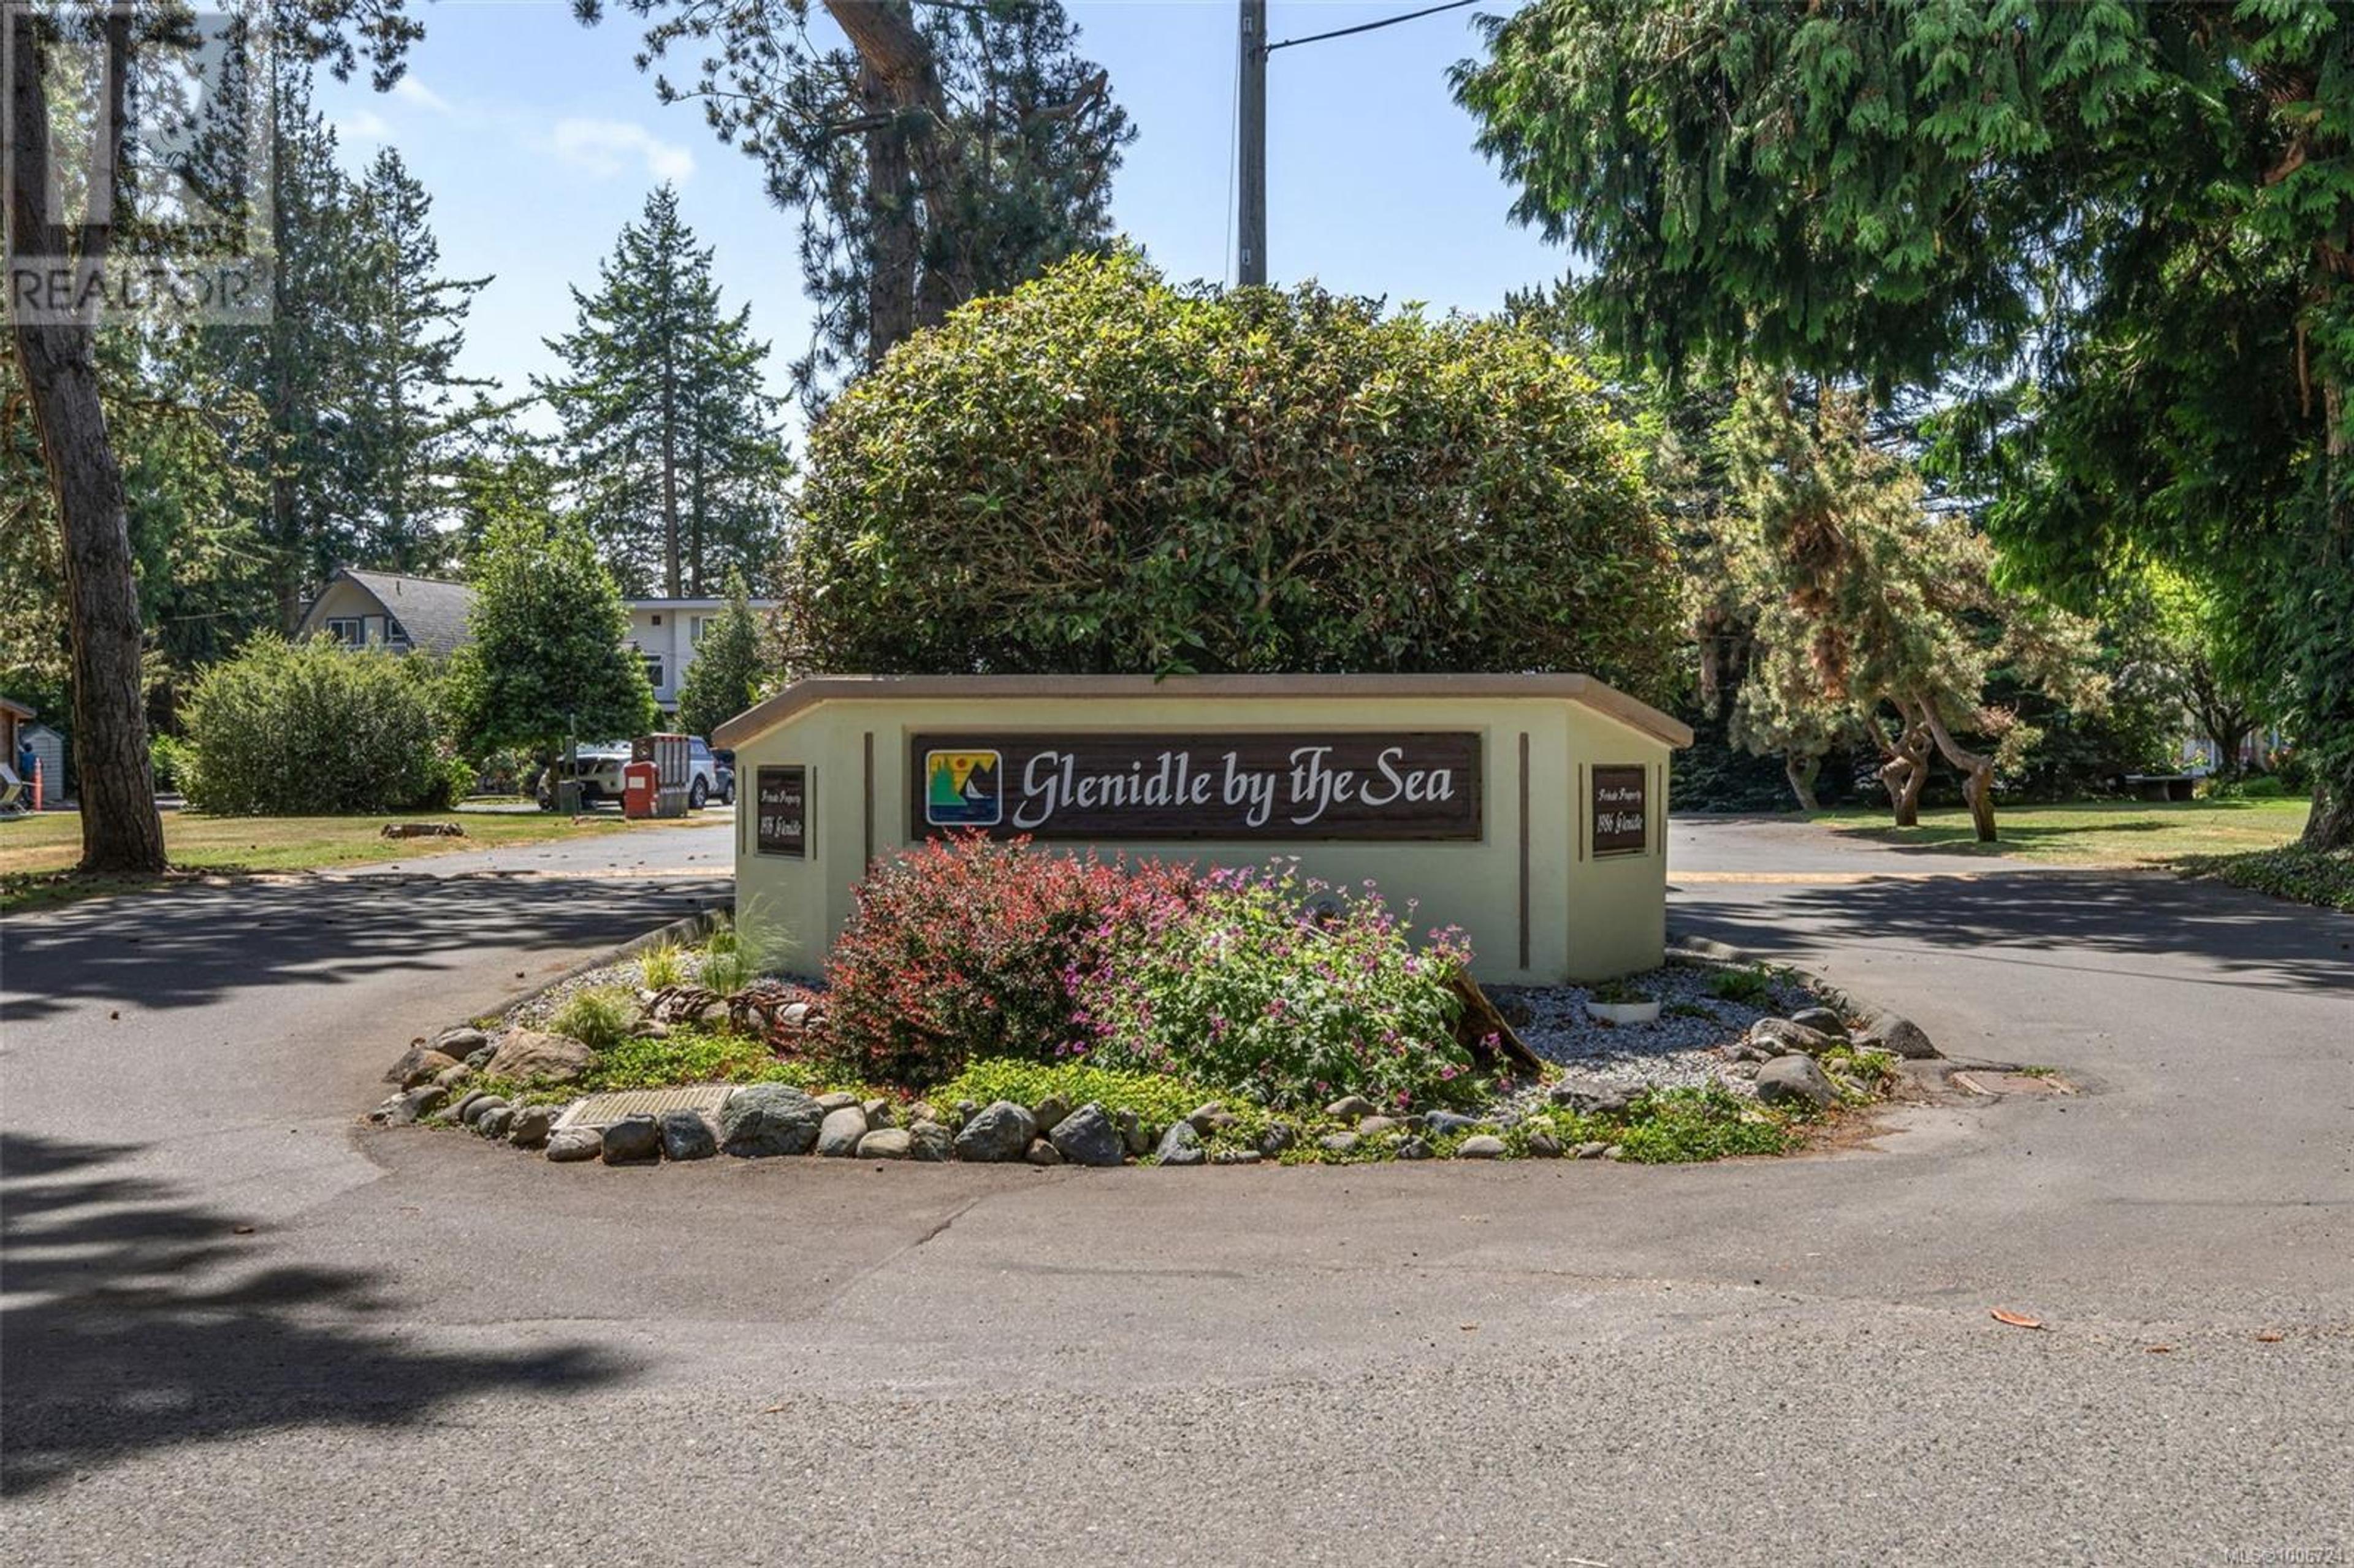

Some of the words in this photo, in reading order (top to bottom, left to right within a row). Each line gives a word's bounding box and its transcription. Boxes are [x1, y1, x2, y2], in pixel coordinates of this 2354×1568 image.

[1012, 751, 1212, 828] Glenidle
[1222, 751, 1276, 828] by
[1360, 747, 1455, 805] Sea
